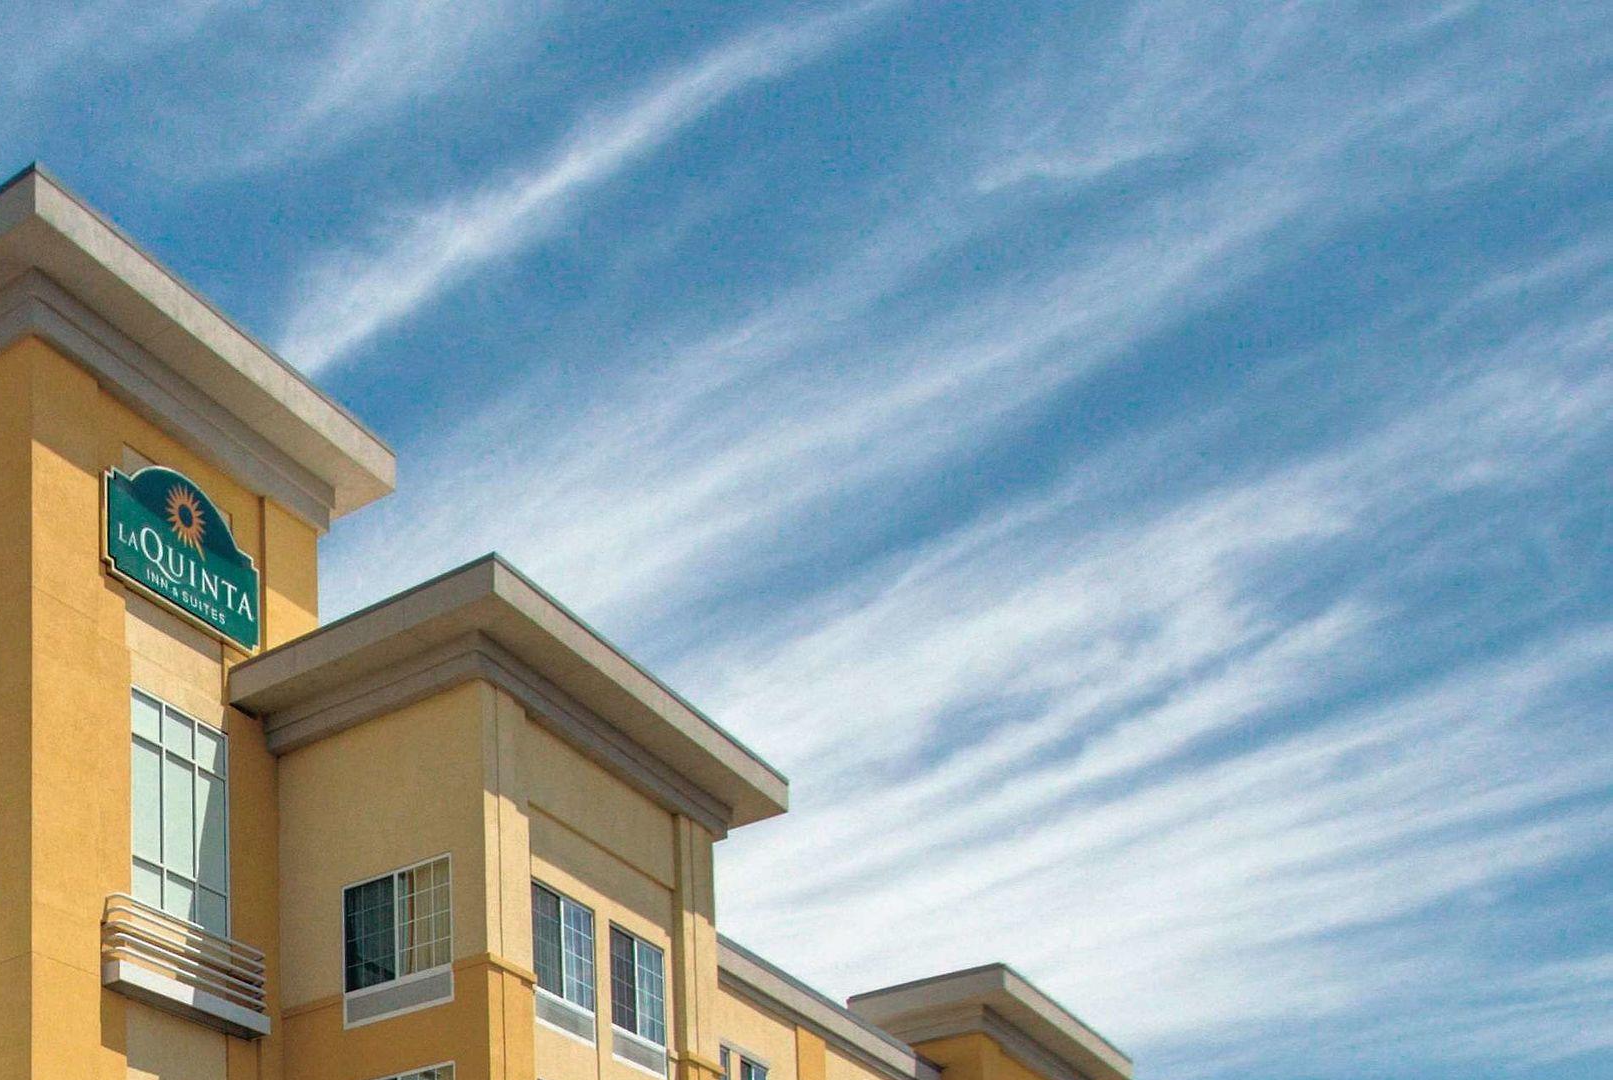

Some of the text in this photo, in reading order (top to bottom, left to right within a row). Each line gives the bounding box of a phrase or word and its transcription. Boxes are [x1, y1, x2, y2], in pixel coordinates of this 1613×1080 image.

[118, 523, 255, 622] LA QUINTA
[146, 568, 226, 625] INN & SUITES
